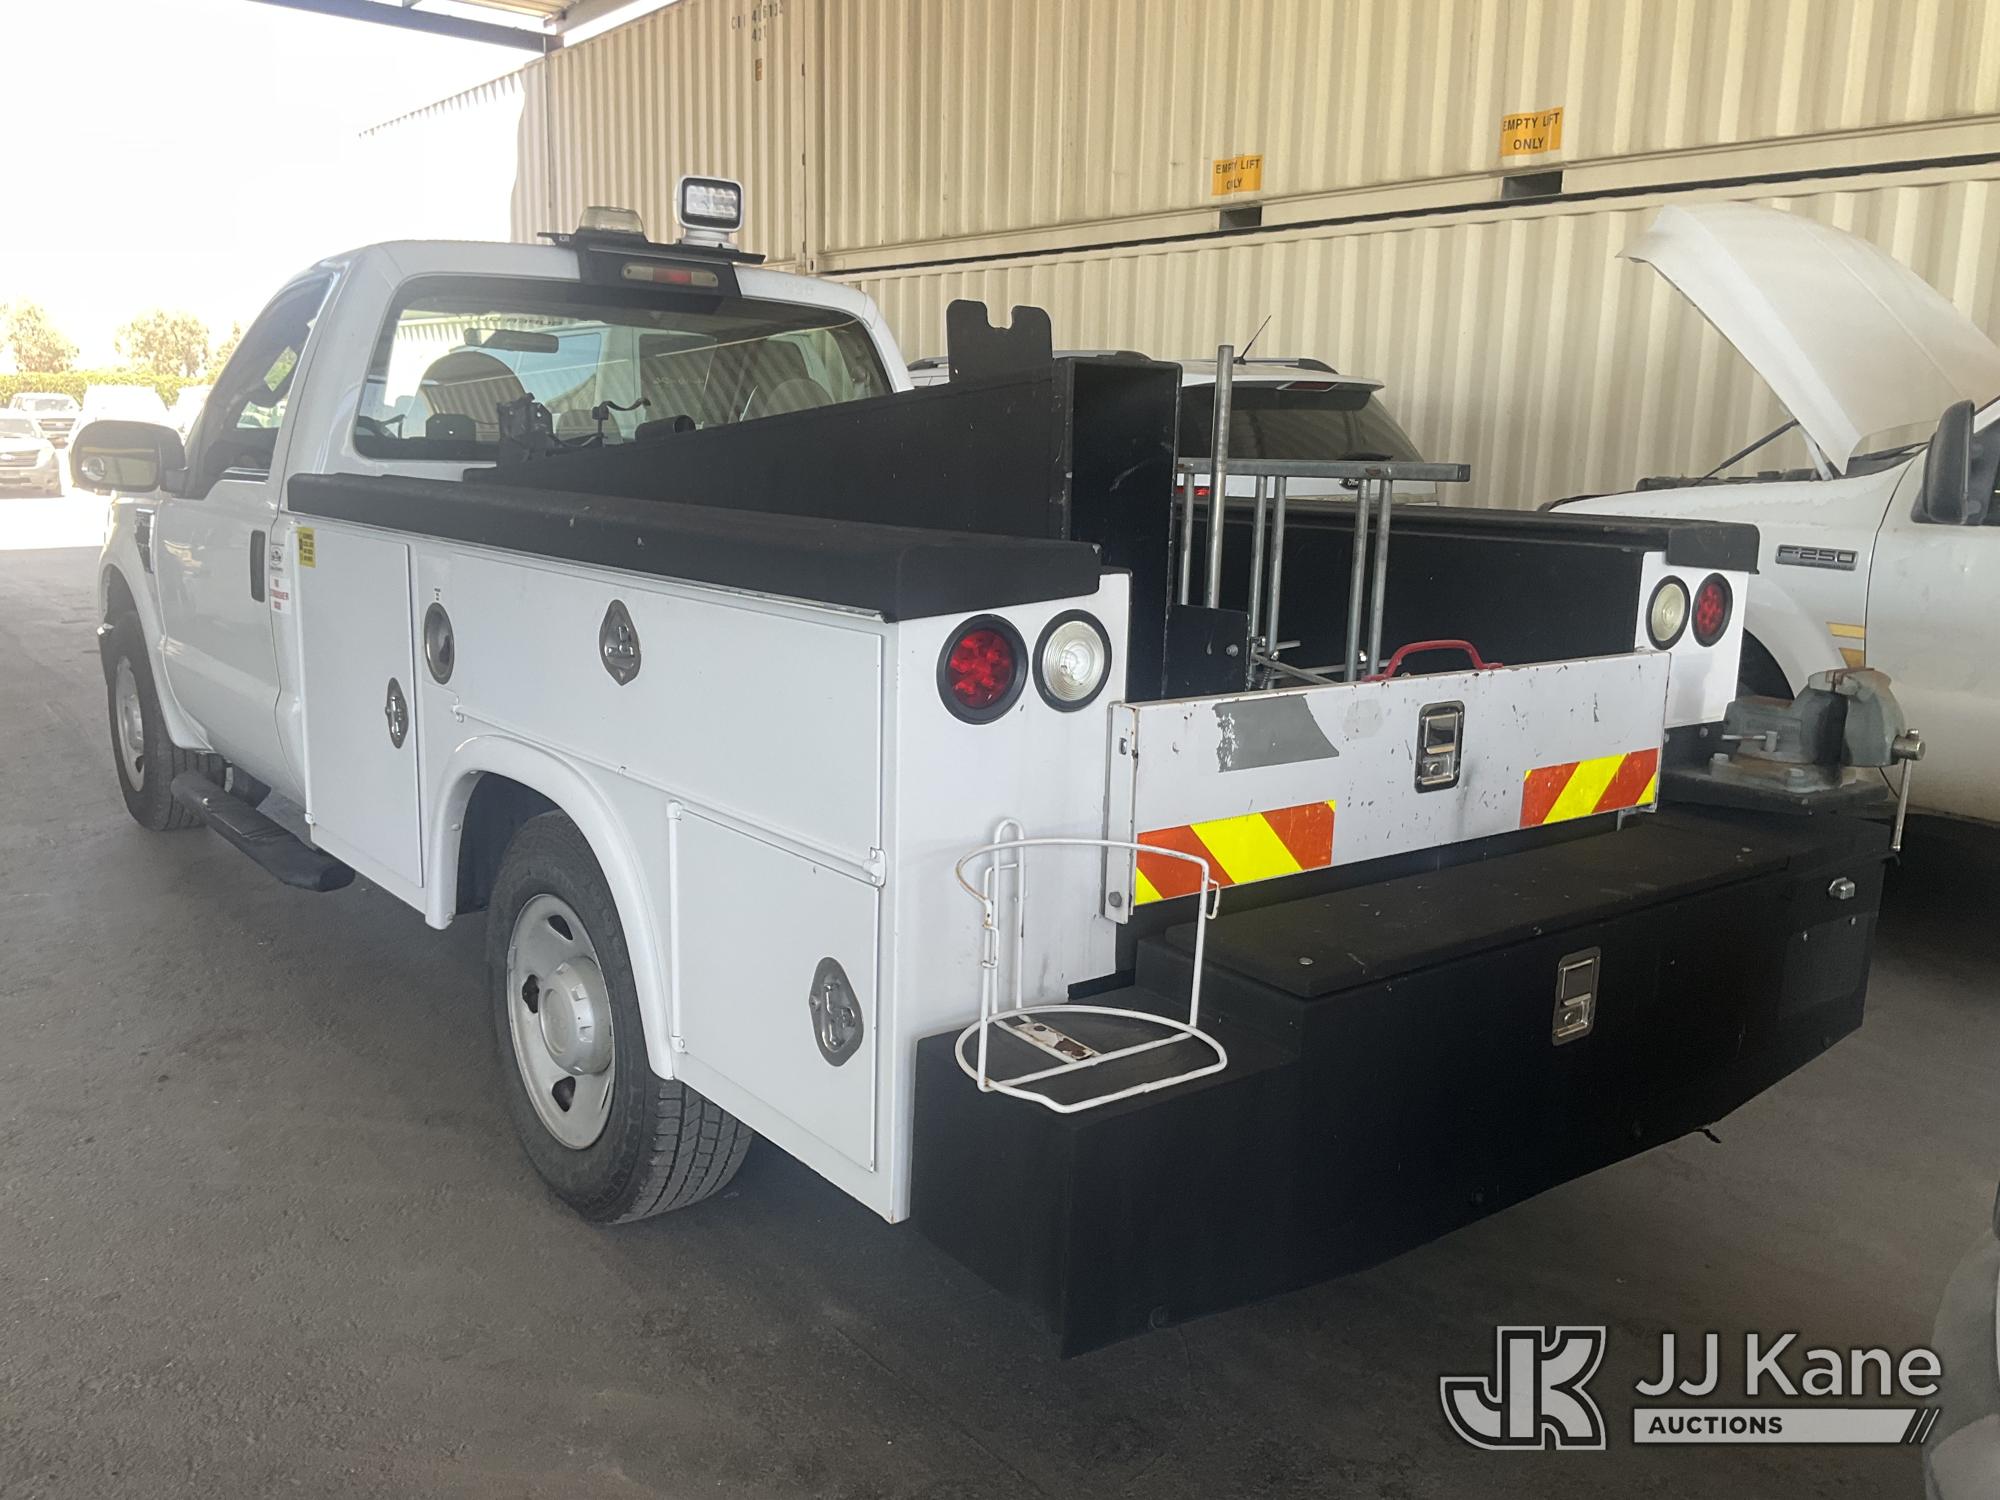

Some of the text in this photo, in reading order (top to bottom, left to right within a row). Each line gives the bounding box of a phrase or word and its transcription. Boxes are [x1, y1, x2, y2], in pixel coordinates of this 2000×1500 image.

[1503, 117, 1538, 131] EMPTY
[1513, 137, 1544, 150] ONLY
[1240, 158, 1260, 169] LIFT
[1226, 177, 1243, 190] OLY
[1778, 546, 1857, 563] F-250
